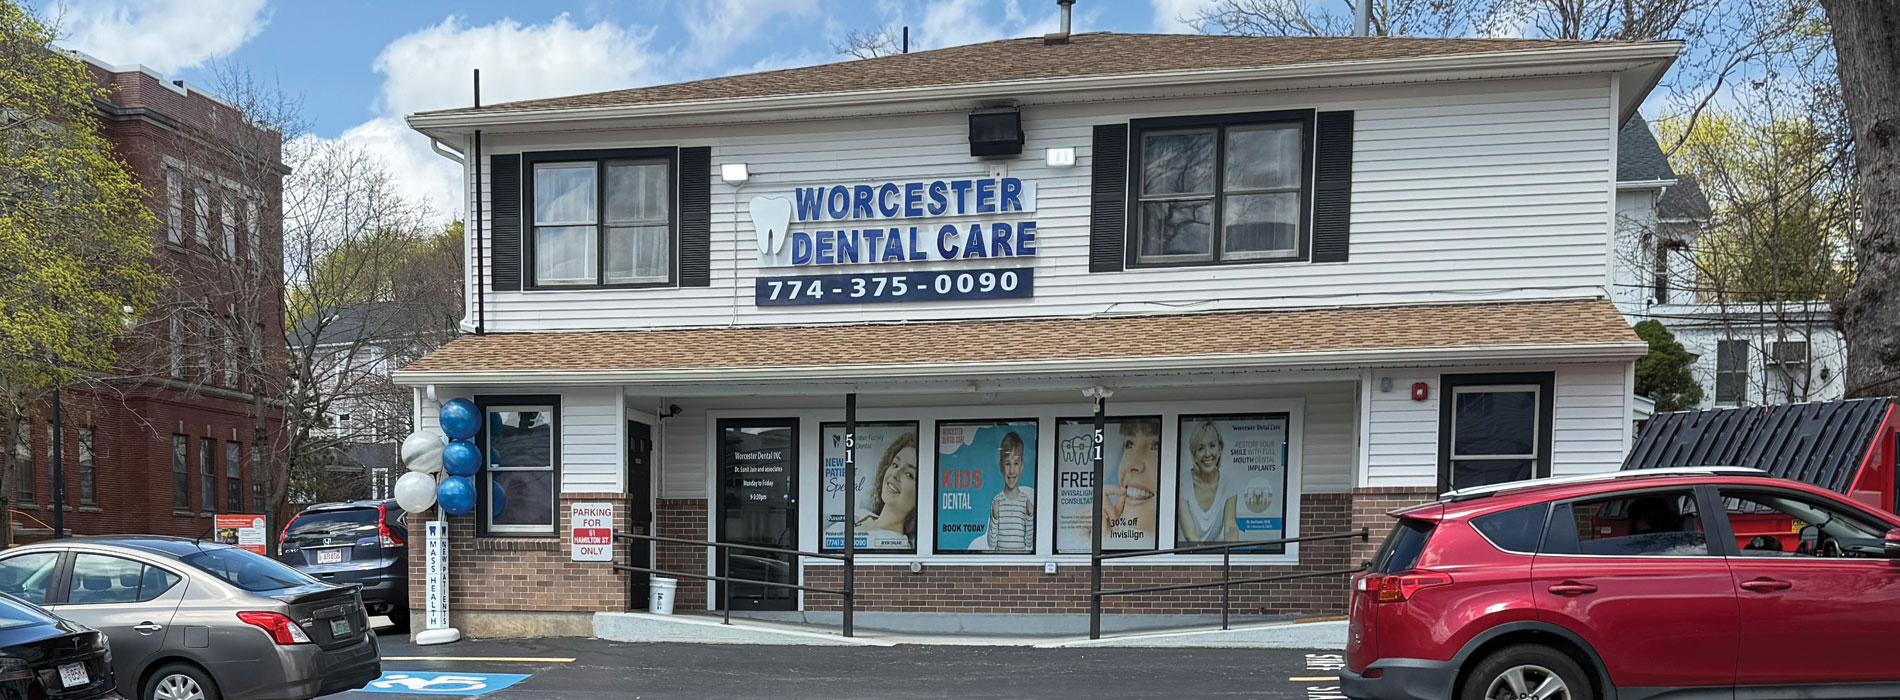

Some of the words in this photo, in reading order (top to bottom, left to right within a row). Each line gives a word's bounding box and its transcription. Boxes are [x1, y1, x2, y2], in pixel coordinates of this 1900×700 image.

[795, 178, 1023, 221] WORCESTER
[791, 227, 927, 265] DENTAL
[937, 221, 1037, 260] CARE
[757, 451, 773, 460] Dental
[825, 458, 844, 467] NEW
[942, 469, 983, 489] KIDS
[1061, 489, 1092, 497] INVISALIGN
[942, 493, 972, 510] DENTAL
[573, 508, 612, 517] PARKING
[583, 518, 601, 527] FOR
[1110, 518, 1126, 528] 30%
[1127, 518, 1139, 526] off
[588, 529, 596, 537] 51
[942, 524, 962, 533] BOOK
[963, 524, 985, 533] TODAY
[573, 536, 601, 545] HAMILTON
[601, 536, 611, 545] ST.
[580, 547, 604, 556] ONLY
[429, 541, 437, 573] MASS
[429, 577, 437, 625] HEALTH
